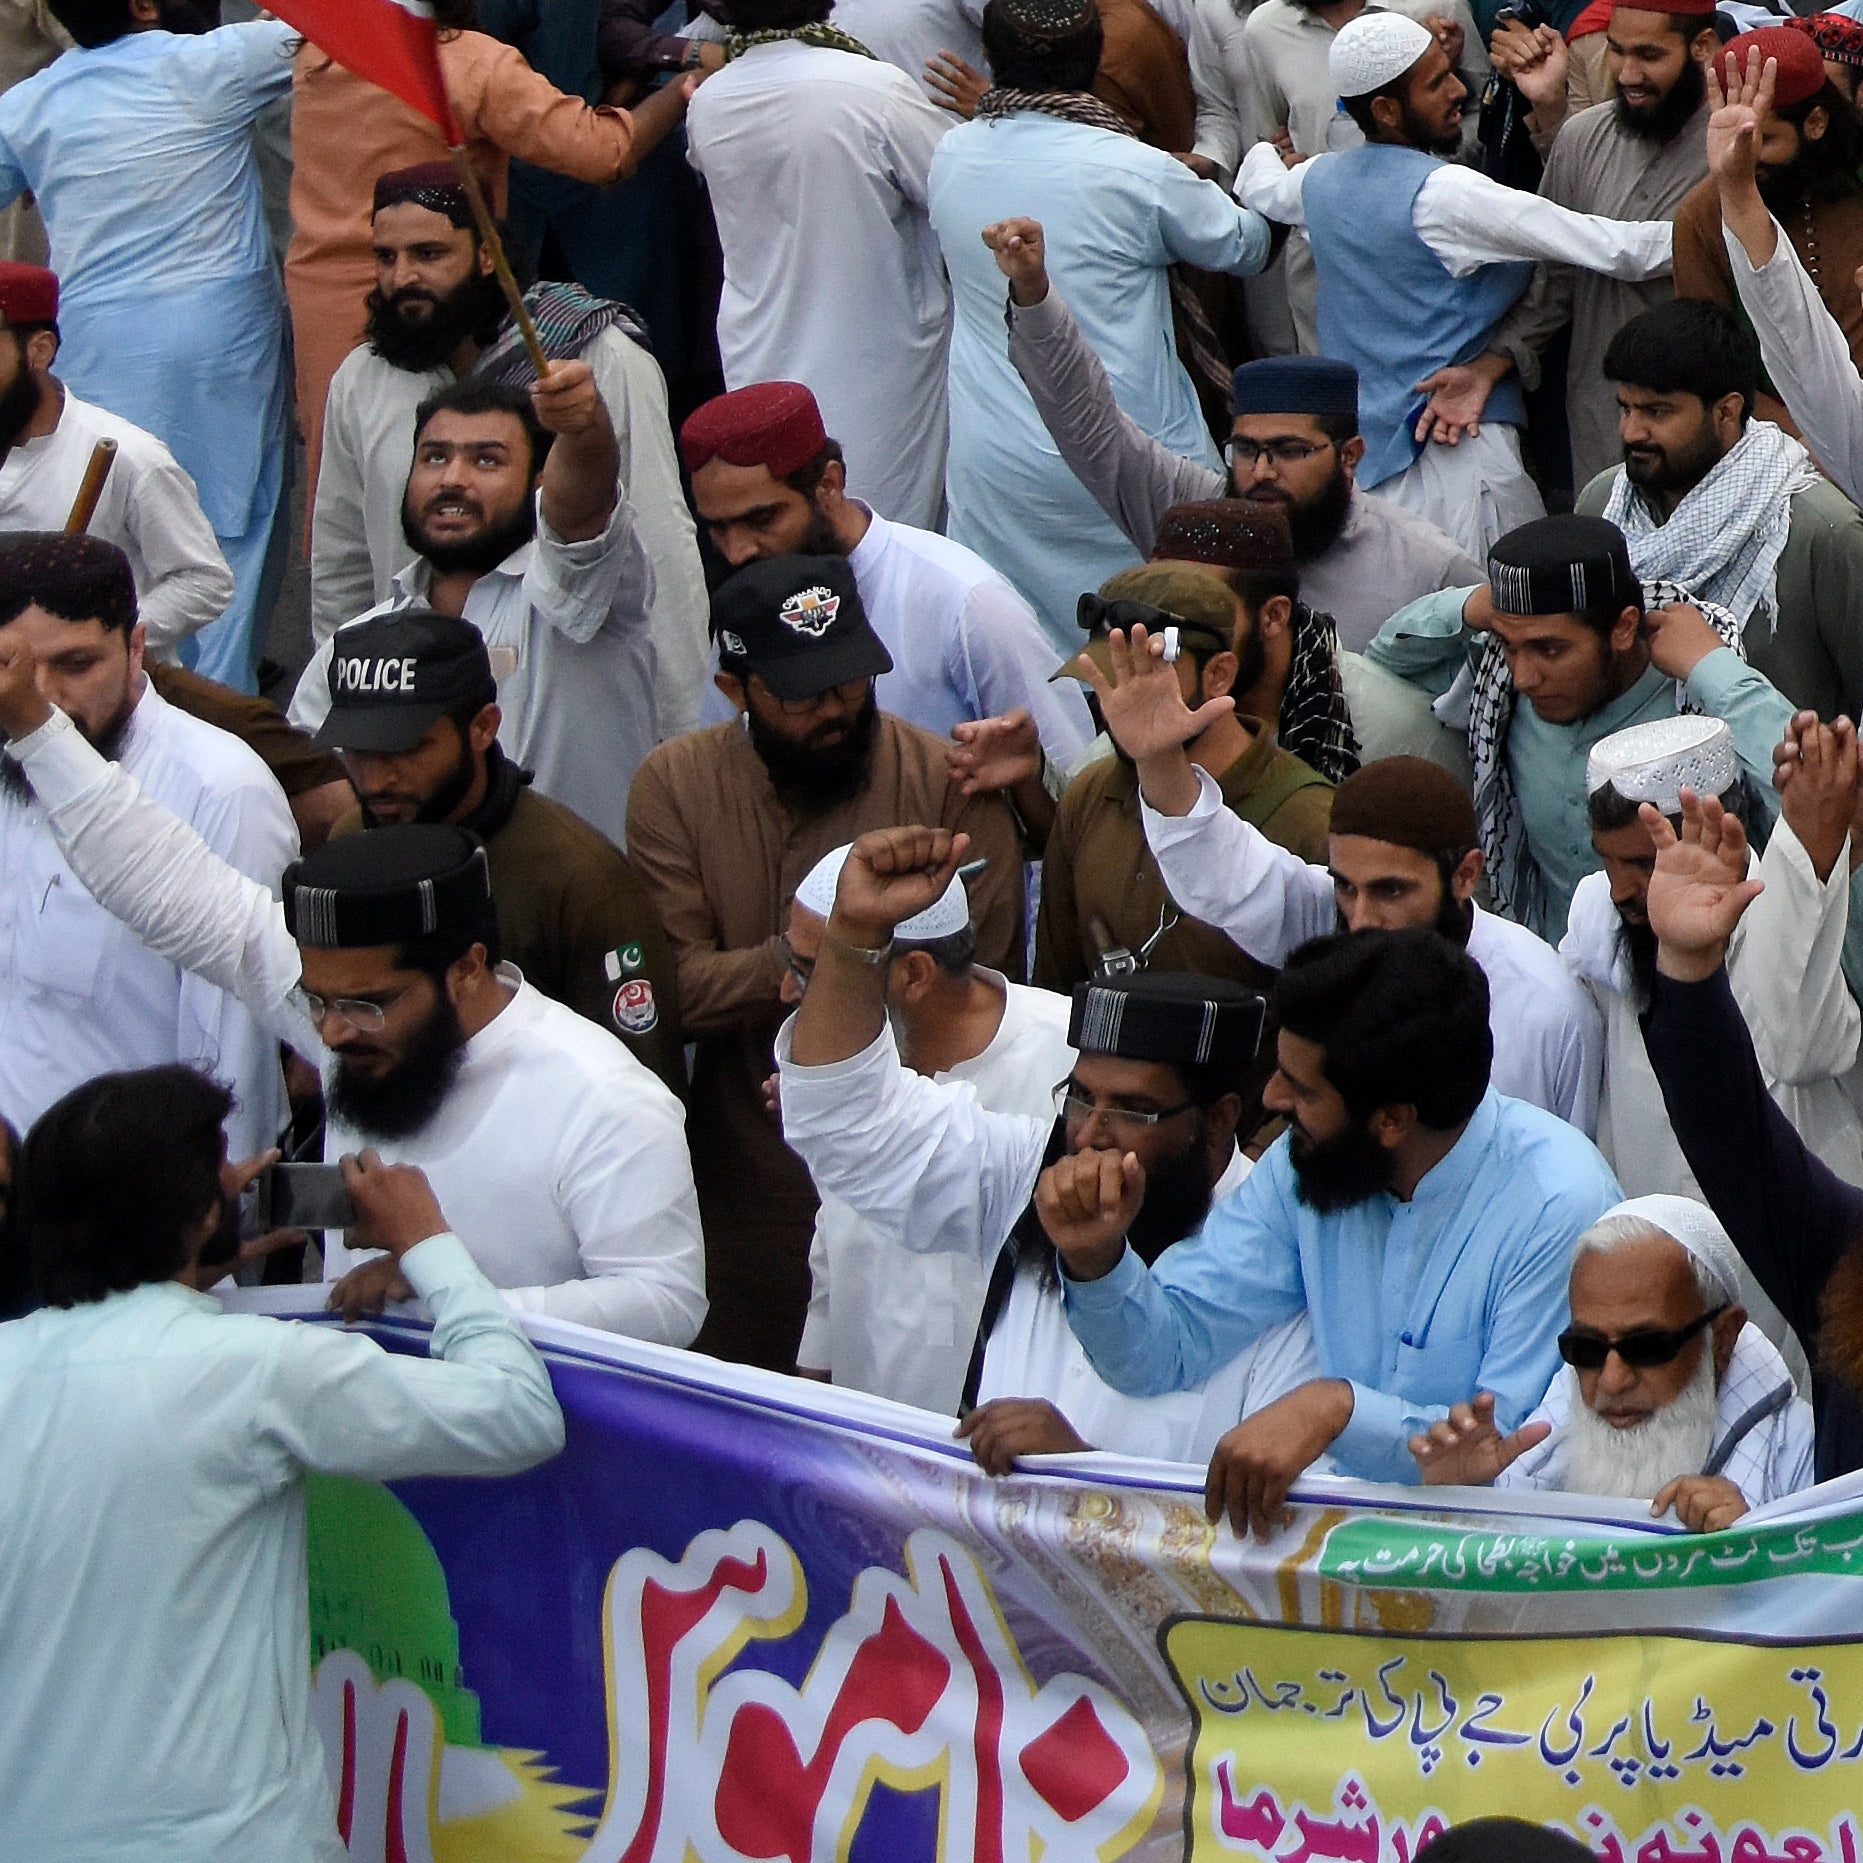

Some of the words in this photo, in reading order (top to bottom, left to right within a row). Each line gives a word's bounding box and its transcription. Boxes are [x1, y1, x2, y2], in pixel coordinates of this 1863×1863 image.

[337, 657, 418, 691] POLICE
[1362, 1541, 1445, 1576] حرمت
[1442, 1534, 1476, 1581] کی
[1200, 1667, 1355, 1719] ترجمان
[1361, 1655, 1407, 1739] کی
[1409, 1670, 1458, 1774] پی
[1458, 1693, 1534, 1767] جے
[1539, 1674, 1594, 1785] بی
[1588, 1717, 1642, 1787] پر
[1644, 1696, 1776, 1778] میڈیا
[1216, 1758, 1382, 1863] شرما
